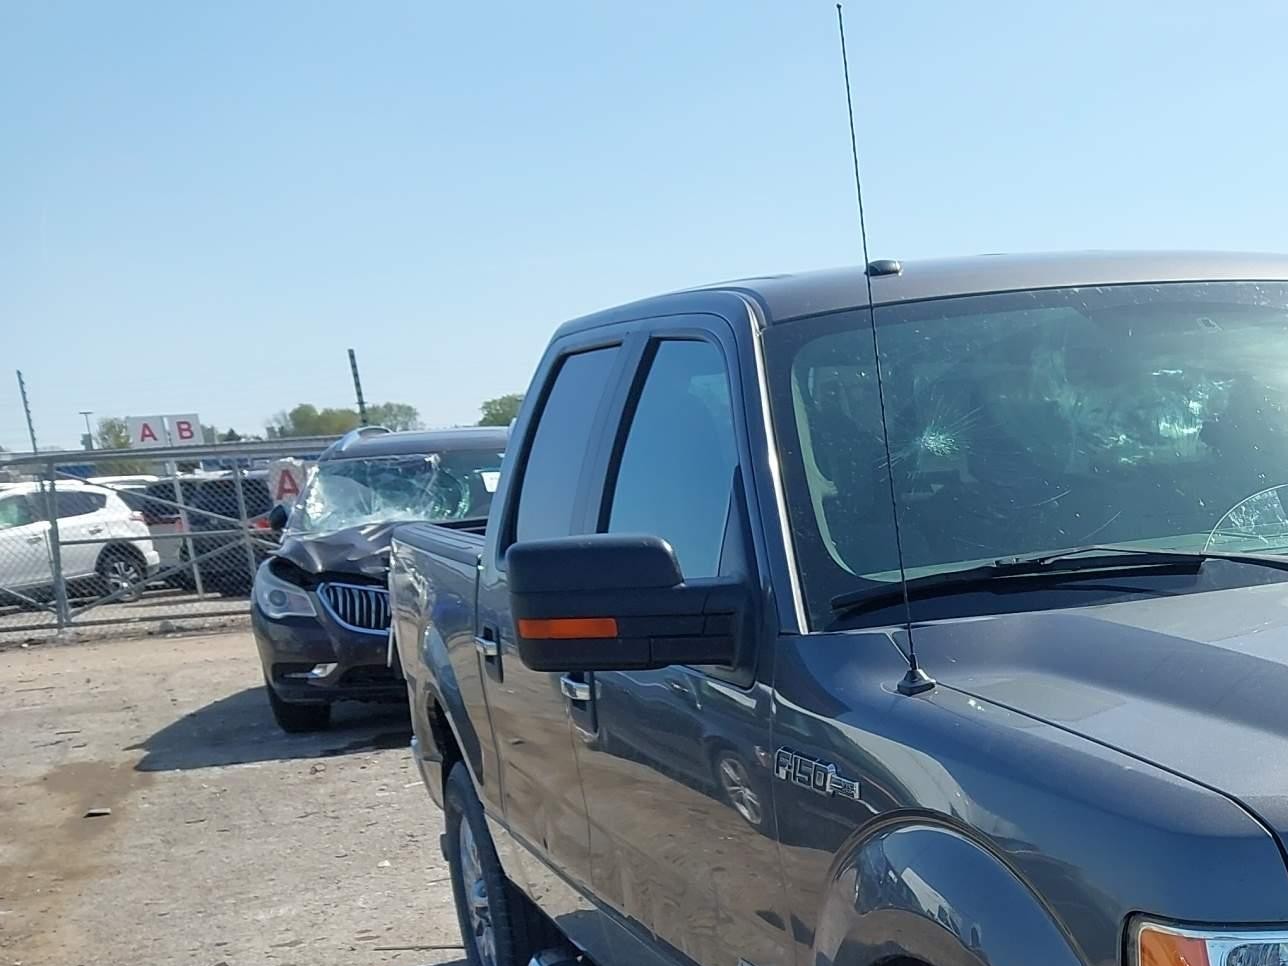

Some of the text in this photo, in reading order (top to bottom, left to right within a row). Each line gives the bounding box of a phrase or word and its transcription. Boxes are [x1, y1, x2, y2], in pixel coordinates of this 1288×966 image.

[141, 421, 194, 442] A B
[277, 469, 299, 500] A
